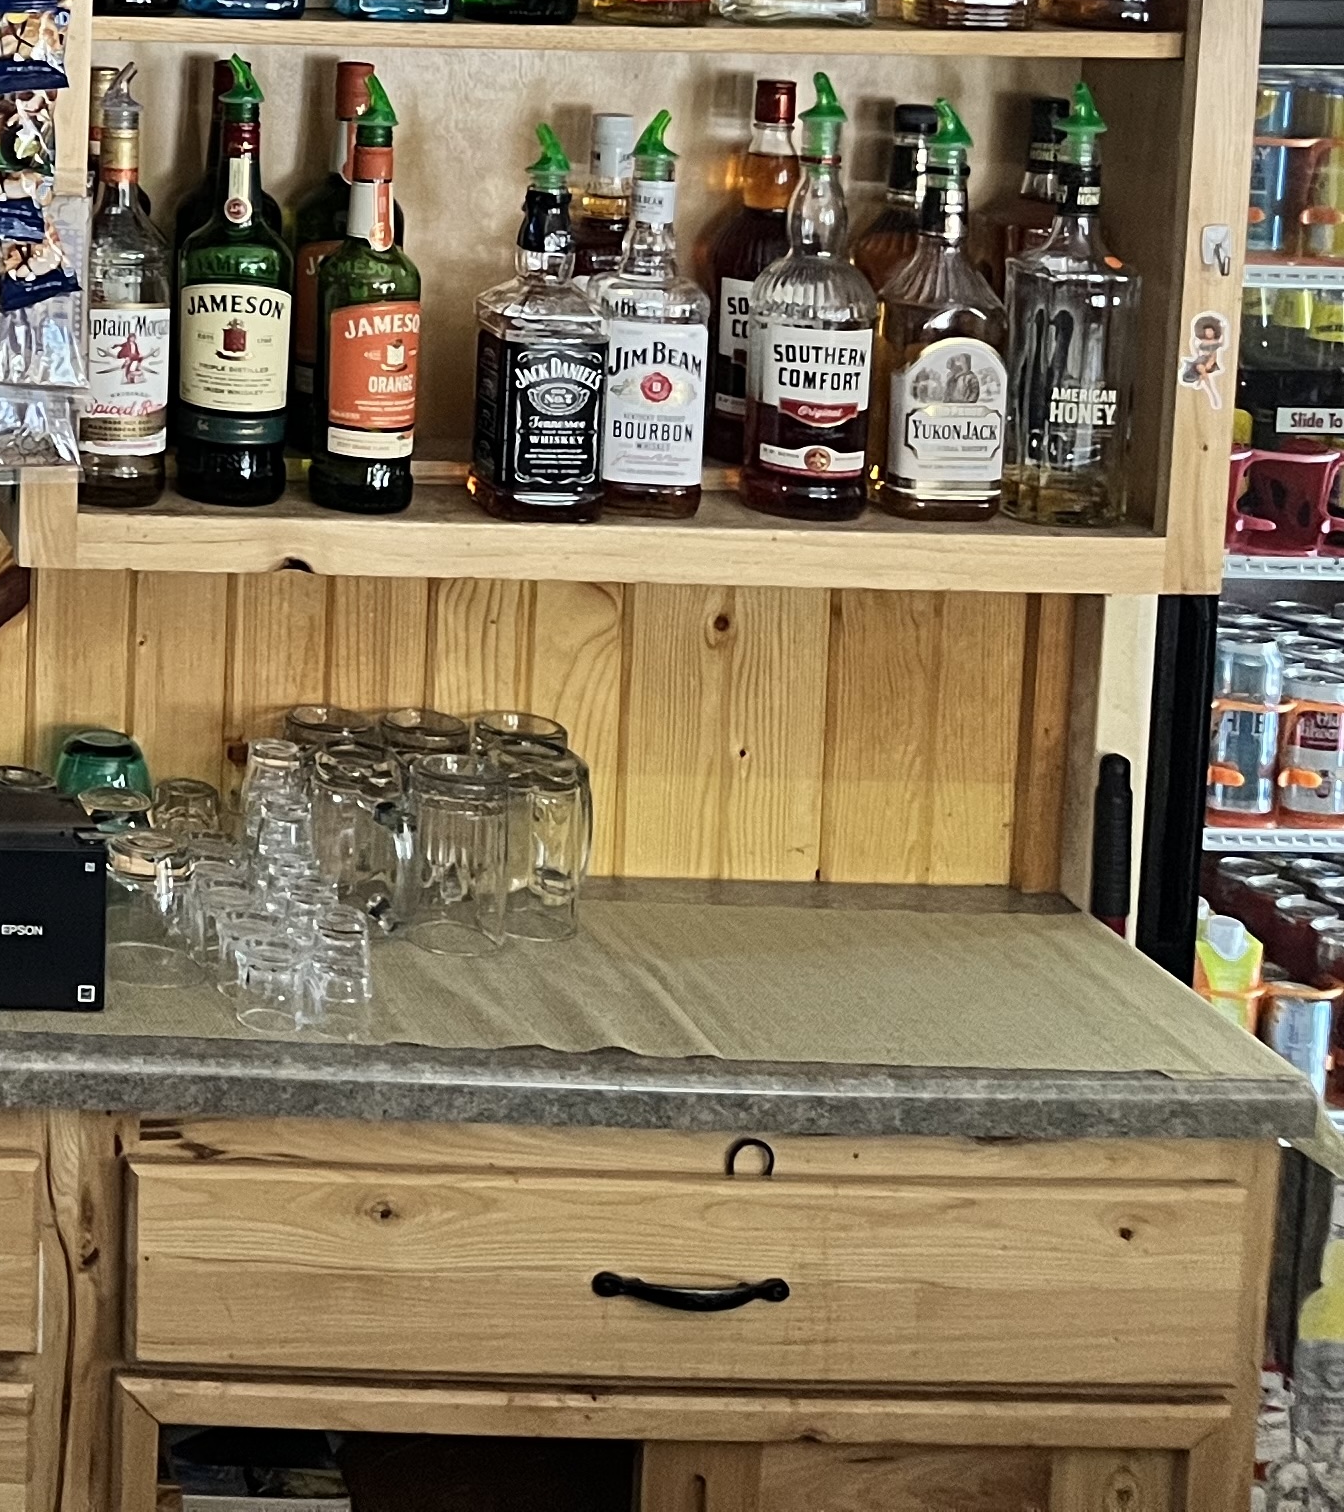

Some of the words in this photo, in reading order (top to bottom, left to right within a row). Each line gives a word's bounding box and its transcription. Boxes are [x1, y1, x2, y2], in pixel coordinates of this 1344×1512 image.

[187, 295, 284, 320] JAMESON
[608, 346, 647, 376] JIM
[652, 341, 702, 378] BEAM
[774, 344, 866, 367] SOUTHERN
[515, 364, 548, 389] JACK
[551, 358, 603, 388] DANIEL'S
[779, 367, 860, 390] COMFORT
[1051, 387, 1117, 403] AMERICAN
[528, 416, 586, 428] Tennessee
[1049, 402, 1116, 426] HONEY
[1290, 411, 1322, 428] Slide
[529, 436, 584, 445] WHISKEY
[613, 420, 693, 442] BOURBON
[912, 419, 961, 441] YUKON
[962, 421, 997, 441] JACK
[0, 925, 44, 937] EPSON
